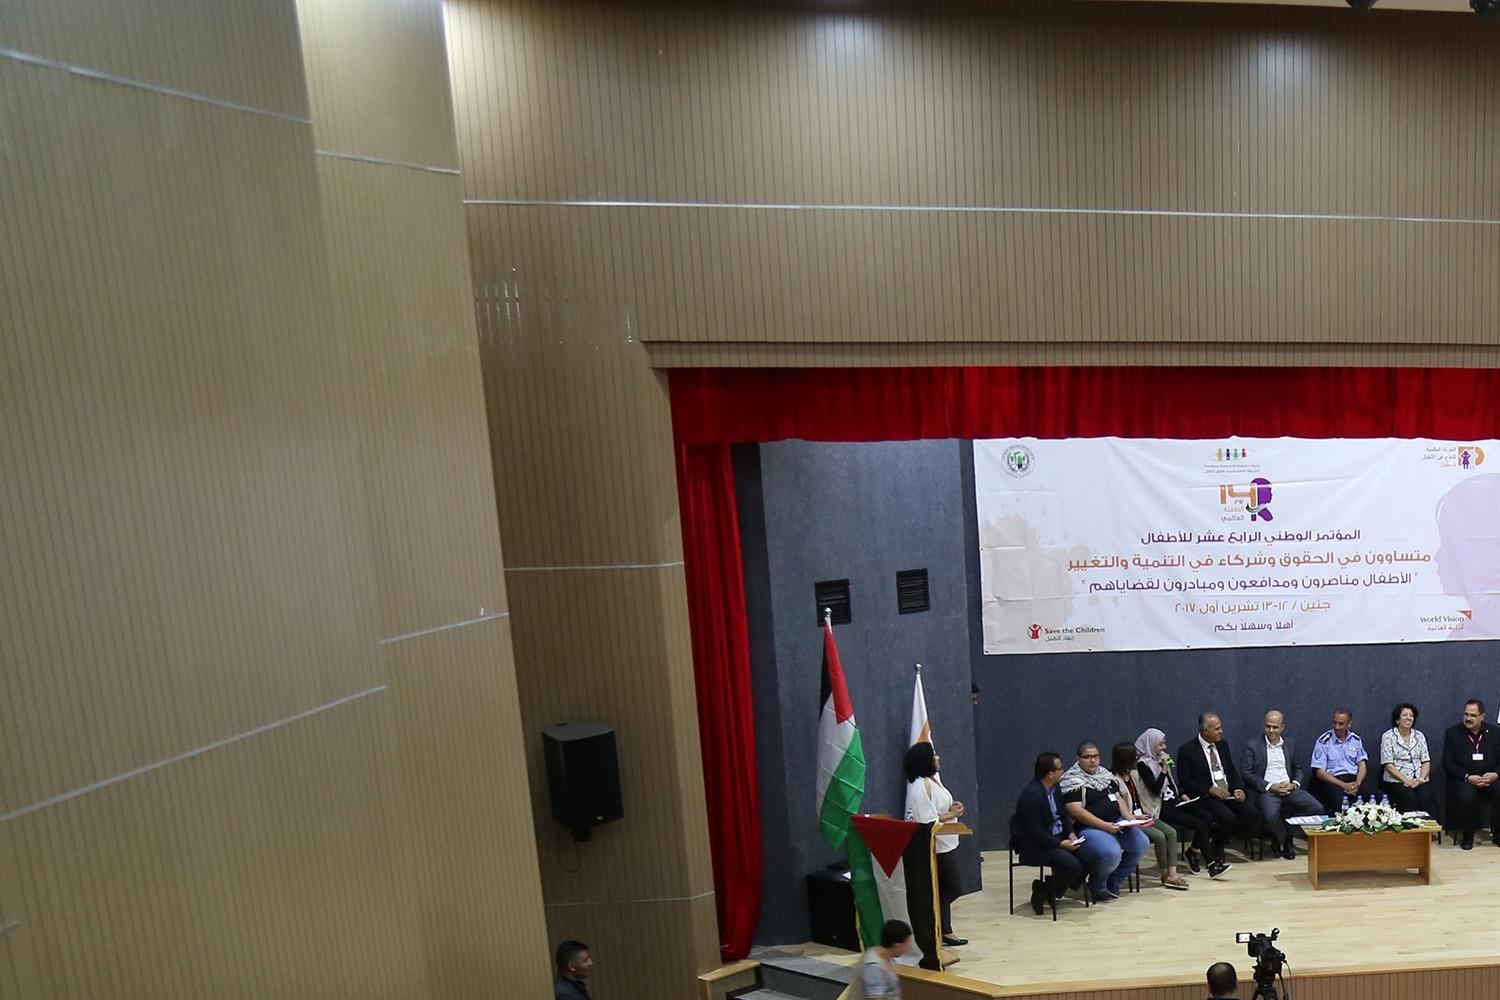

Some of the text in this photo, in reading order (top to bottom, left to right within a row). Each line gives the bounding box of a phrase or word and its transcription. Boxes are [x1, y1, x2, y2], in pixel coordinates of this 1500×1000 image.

[1140, 529, 1361, 546] المؤتمر الوطني الرابع عشر للأطفال
[1067, 550, 1431, 572] متساوون في الحقوق وشركاء في التنمية والتغيير
[1089, 578, 1160, 593] لقضاياهم
[1163, 578, 1224, 592] ومبادرون
[1228, 576, 1298, 591] ومدافعون
[1302, 574, 1359, 589] مناصرون
[1362, 571, 1412, 587] الأطفال
[1200, 600, 1218, 614] أول
[1222, 600, 1258, 614] تشرين
[1300, 600, 1331, 612] جنين
[1214, 622, 1238, 632] بكم
